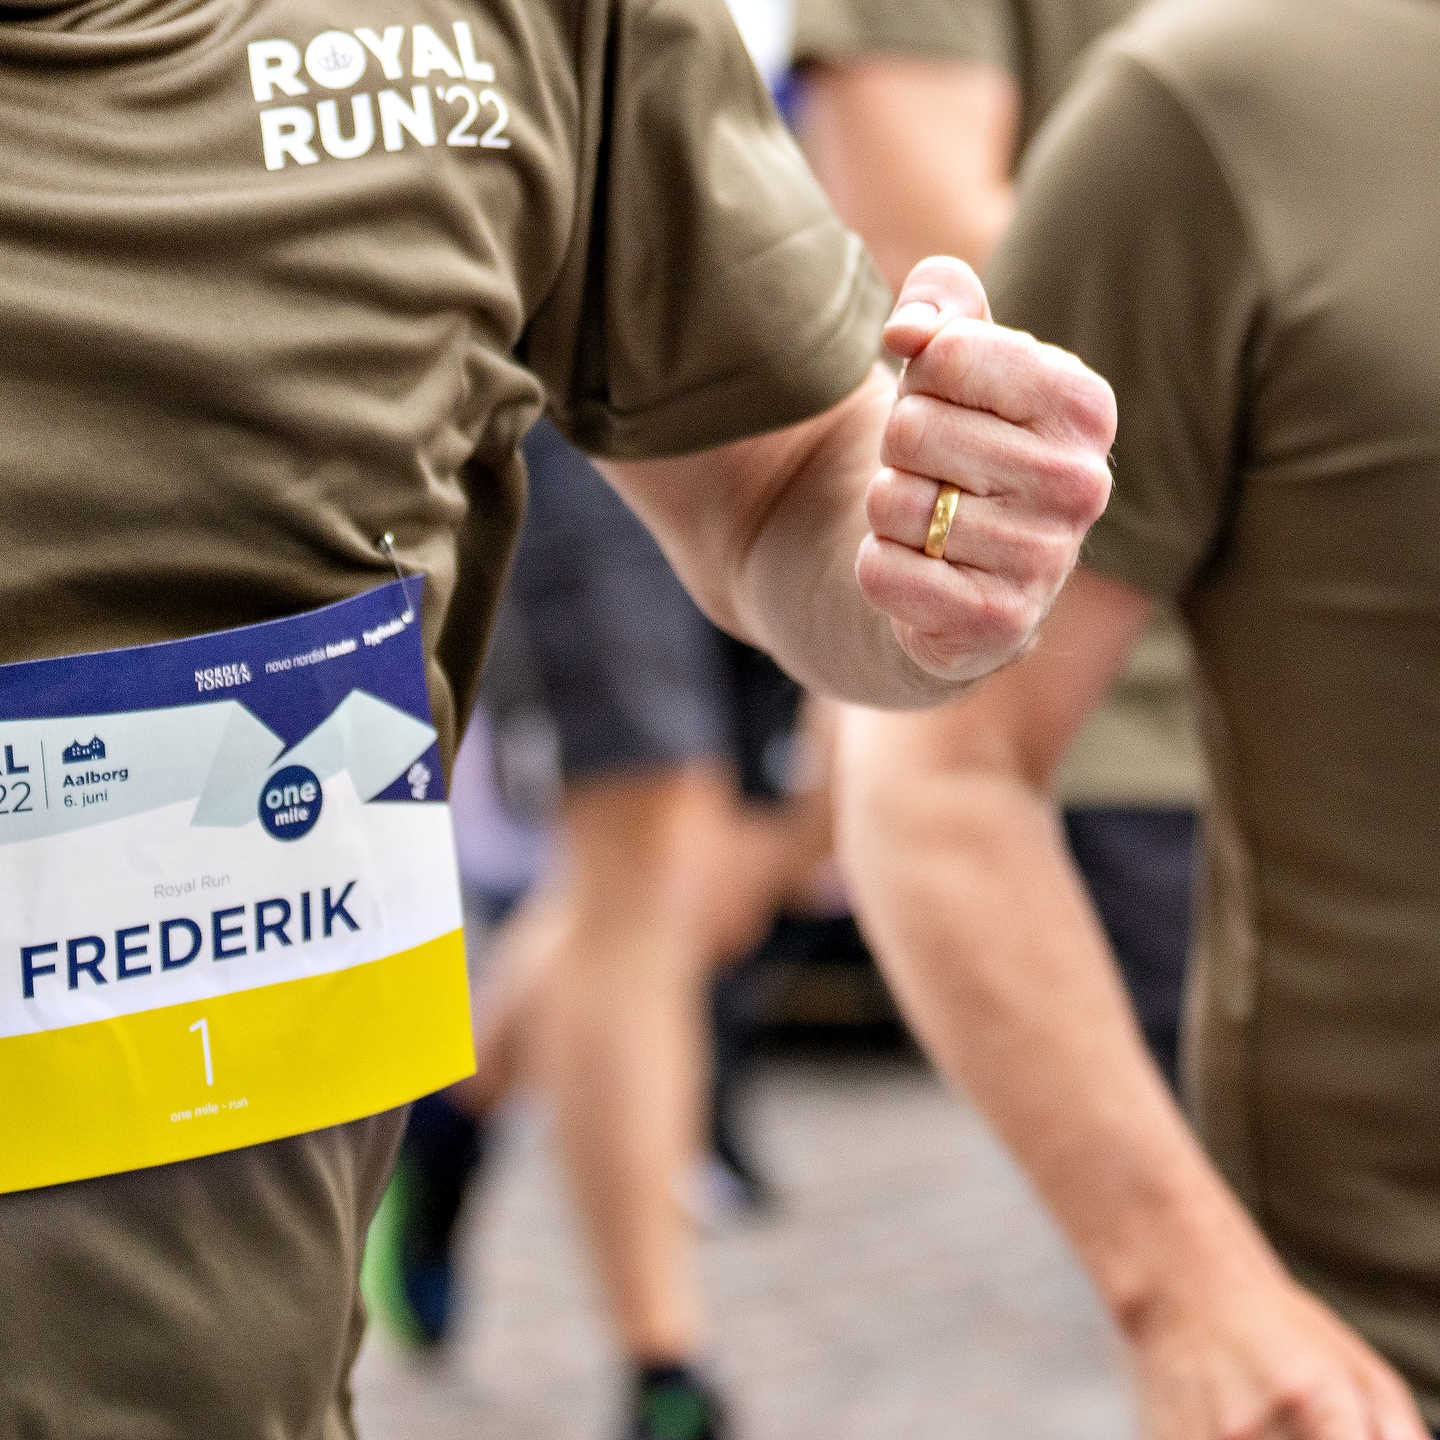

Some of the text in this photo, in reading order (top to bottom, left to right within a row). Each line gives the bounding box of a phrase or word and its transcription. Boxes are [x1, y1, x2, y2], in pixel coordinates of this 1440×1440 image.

[247, 21, 495, 103] ROYAL
[194, 661, 248, 682] NORDEA
[196, 670, 252, 692] FONDEN
[62, 767, 129, 788] Aalborg
[63, 788, 109, 808] 6. juni
[265, 779, 317, 810] one
[274, 806, 310, 827] mile
[153, 873, 231, 899] Royal Run
[19, 879, 362, 999] FREDERIK
[188, 1017, 214, 1086] 1
[170, 1108, 193, 1122] one
